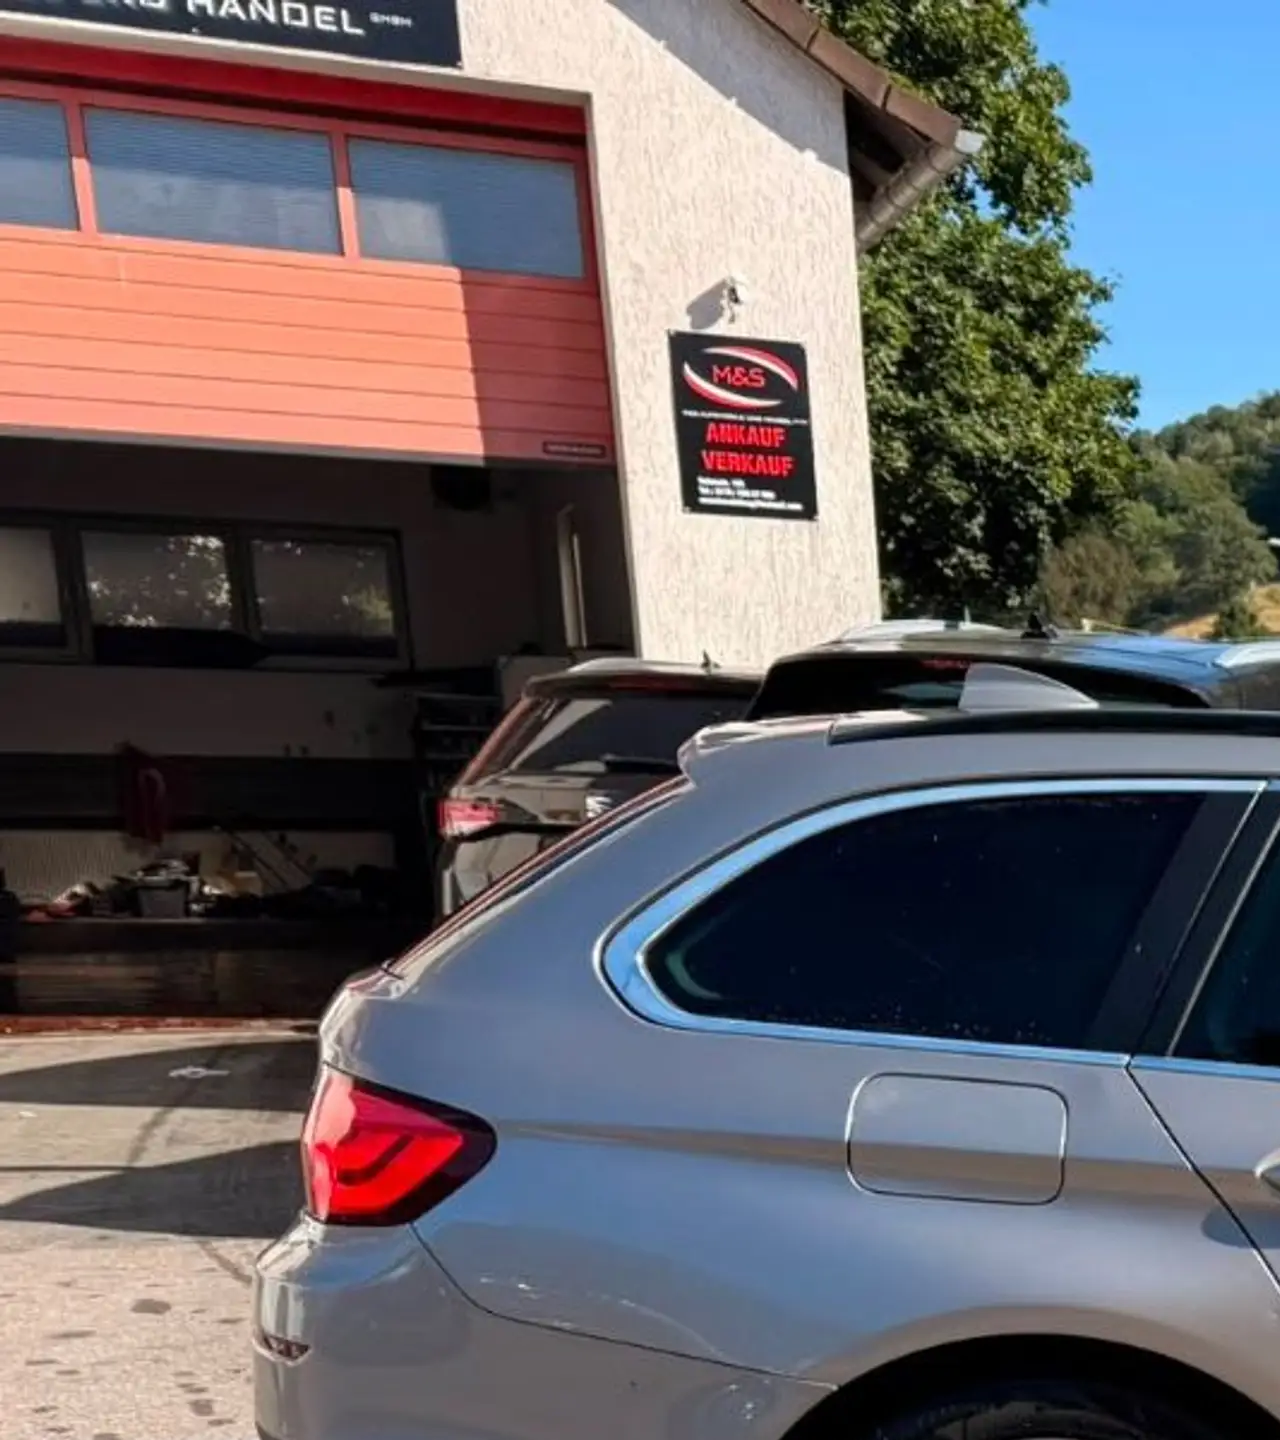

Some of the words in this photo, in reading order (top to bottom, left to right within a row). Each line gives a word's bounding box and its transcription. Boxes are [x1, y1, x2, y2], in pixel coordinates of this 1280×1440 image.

[186, 0, 366, 36] HANDEL
[712, 365, 766, 388] M&S
[705, 422, 786, 448] ANKAUF
[701, 450, 794, 477] VERKAUF
